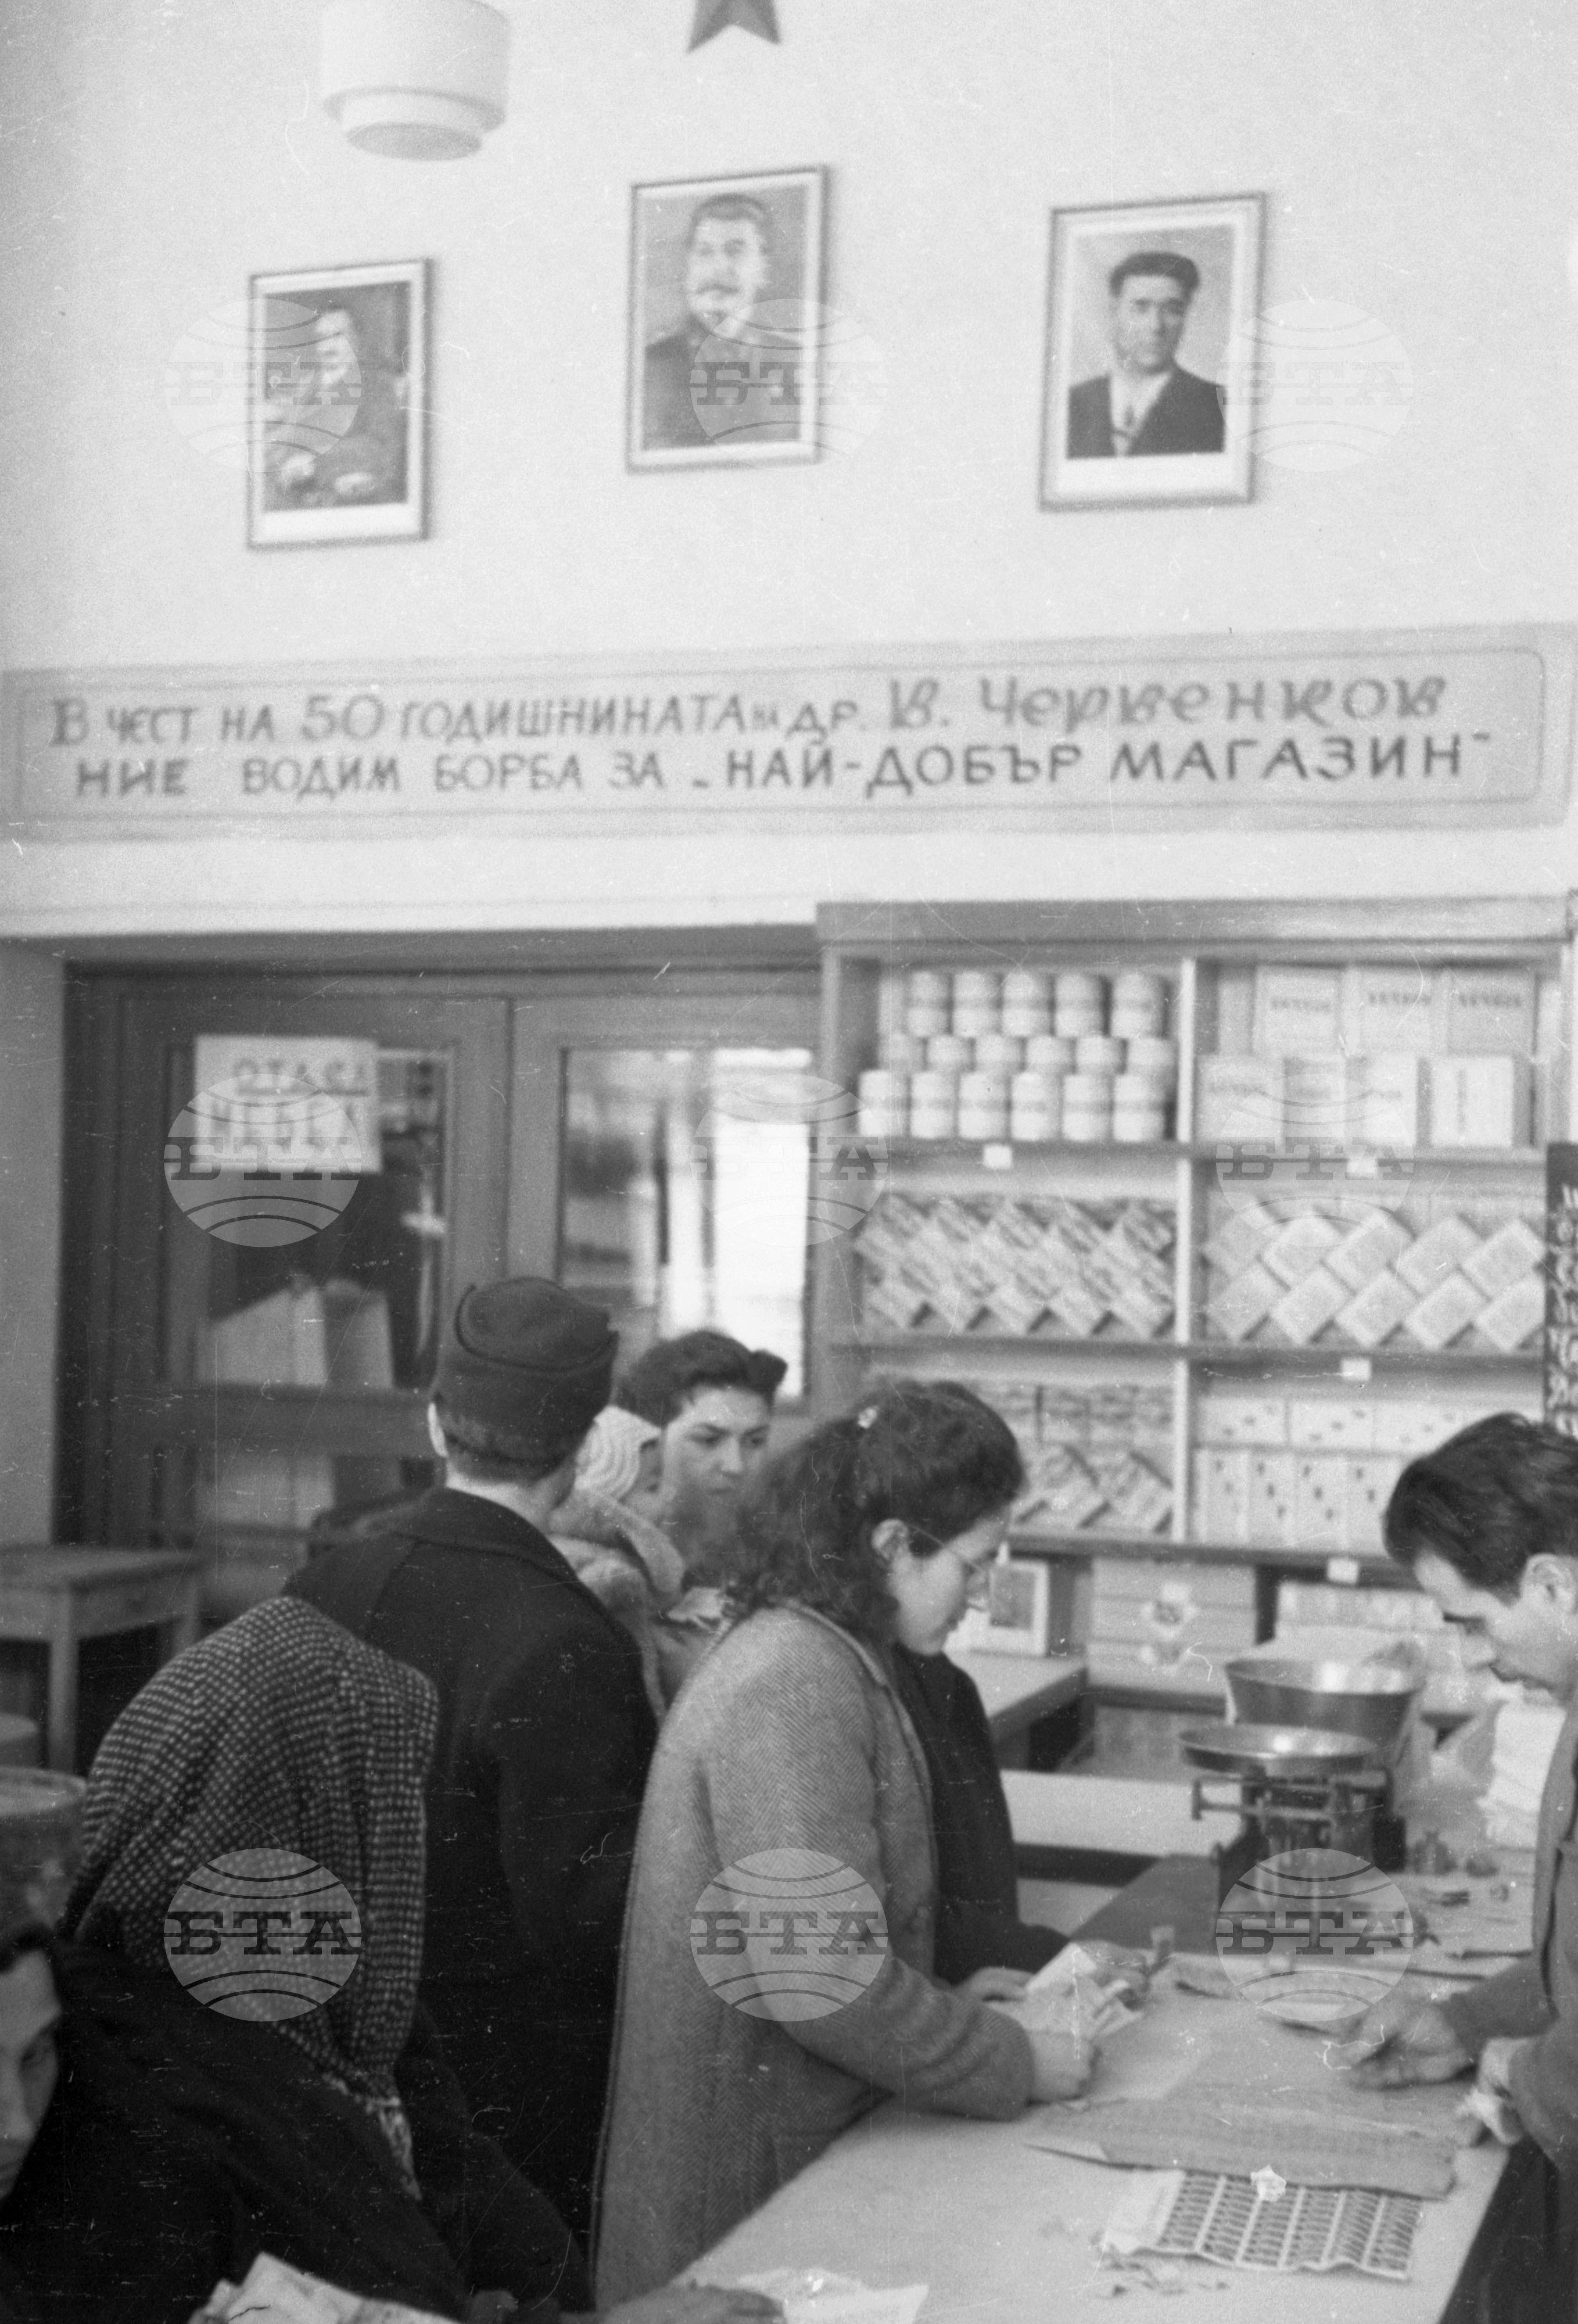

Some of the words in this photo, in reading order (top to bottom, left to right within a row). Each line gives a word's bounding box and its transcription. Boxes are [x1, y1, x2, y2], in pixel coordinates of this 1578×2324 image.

[50, 697, 89, 747] В
[218, 704, 276, 743] НА
[299, 693, 388, 743] 50
[401, 693, 746, 745] ГОДИШНИНАТА
[76, 758, 189, 798] НИЕ
[241, 756, 402, 801] ВОДИМ
[433, 753, 583, 791] БОРБА
[607, 749, 666, 791] ЗА
